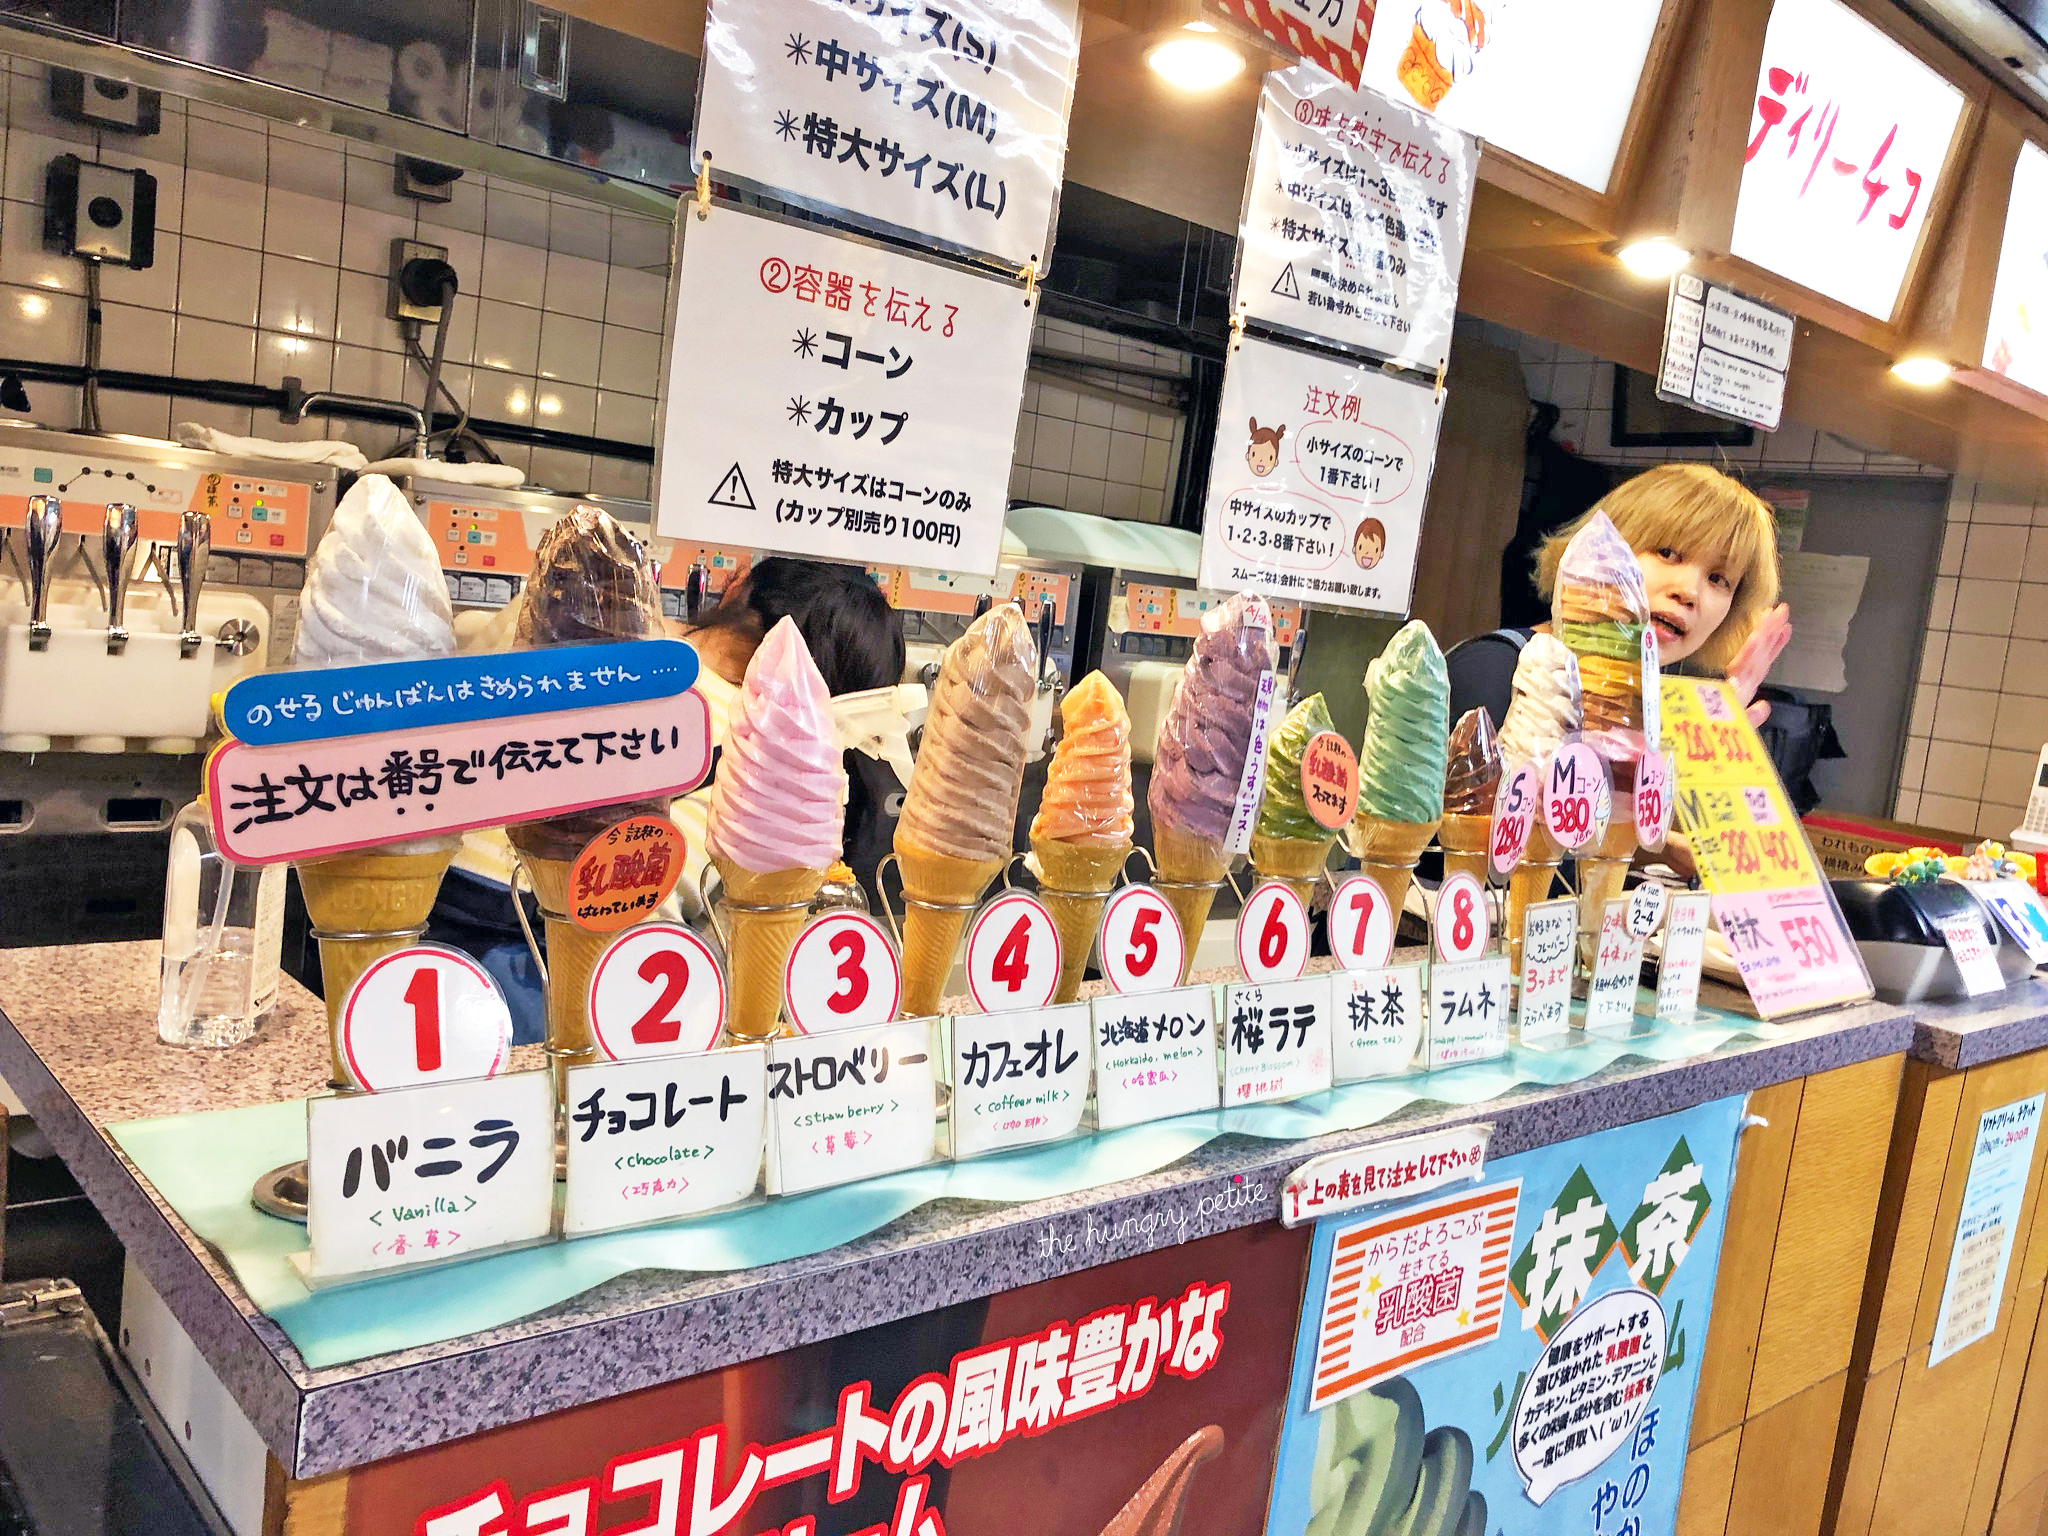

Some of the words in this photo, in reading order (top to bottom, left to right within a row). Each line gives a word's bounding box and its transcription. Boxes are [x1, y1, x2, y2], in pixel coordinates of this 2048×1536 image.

[803, 112, 1006, 219] 特大サイズ(L)
[760, 257, 959, 337] ②容器を伝える
[822, 331, 913, 379] コーン
[814, 397, 908, 445] カップ
[1303, 385, 1361, 423] 注文例
[1307, 437, 1403, 472] 小サイズのコーンで
[772, 458, 971, 512] 特大サイズはコーンのみ
[775, 498, 961, 547] (カップ別売り100円)
[1230, 498, 1331, 530] 中サイズのカップで
[231, 726, 678, 833] 注文は番号で伝えて下さい
[1508, 773, 1526, 812] S
[1553, 755, 1575, 794] M
[1495, 815, 1525, 856] 280
[1552, 797, 1590, 833] 380
[1638, 790, 1661, 828] 550
[1823, 836, 1885, 854] われもの
[1125, 908, 1162, 977] 5
[1259, 898, 1286, 968] 6
[1349, 893, 1374, 956] 7
[1452, 893, 1475, 951] 8
[1633, 909, 1654, 926] 2-4
[1780, 916, 1839, 969] 550
[827, 929, 869, 1014] 3
[991, 913, 1032, 992] 4
[404, 968, 440, 1071] 1
[631, 950, 690, 1044] 2
[1235, 991, 1262, 1005] さくら
[1347, 983, 1405, 1032] 抹茶
[1441, 981, 1496, 1025] ラムネ
[1100, 1012, 1205, 1047] 北海道メロン
[1231, 1004, 1316, 1054] 桜ラテ
[767, 1045, 928, 1099] ストロベリー
[962, 1029, 1078, 1088] カフェオレ
[573, 1076, 747, 1142] チョコレート
[343, 1120, 519, 1198] バニラ
[1307, 1148, 1467, 1206] 上の表を見て注文して下さい
[1368, 1211, 1484, 1266] からだよろこぶ
[1521, 1162, 1703, 1331] 抹茶
[1398, 1250, 1450, 1282] 生きてる
[1375, 1266, 1464, 1336] 乳酸菌
[1400, 1323, 1426, 1348] 配合
[1547, 1309, 1650, 1369] 健康をサポートする
